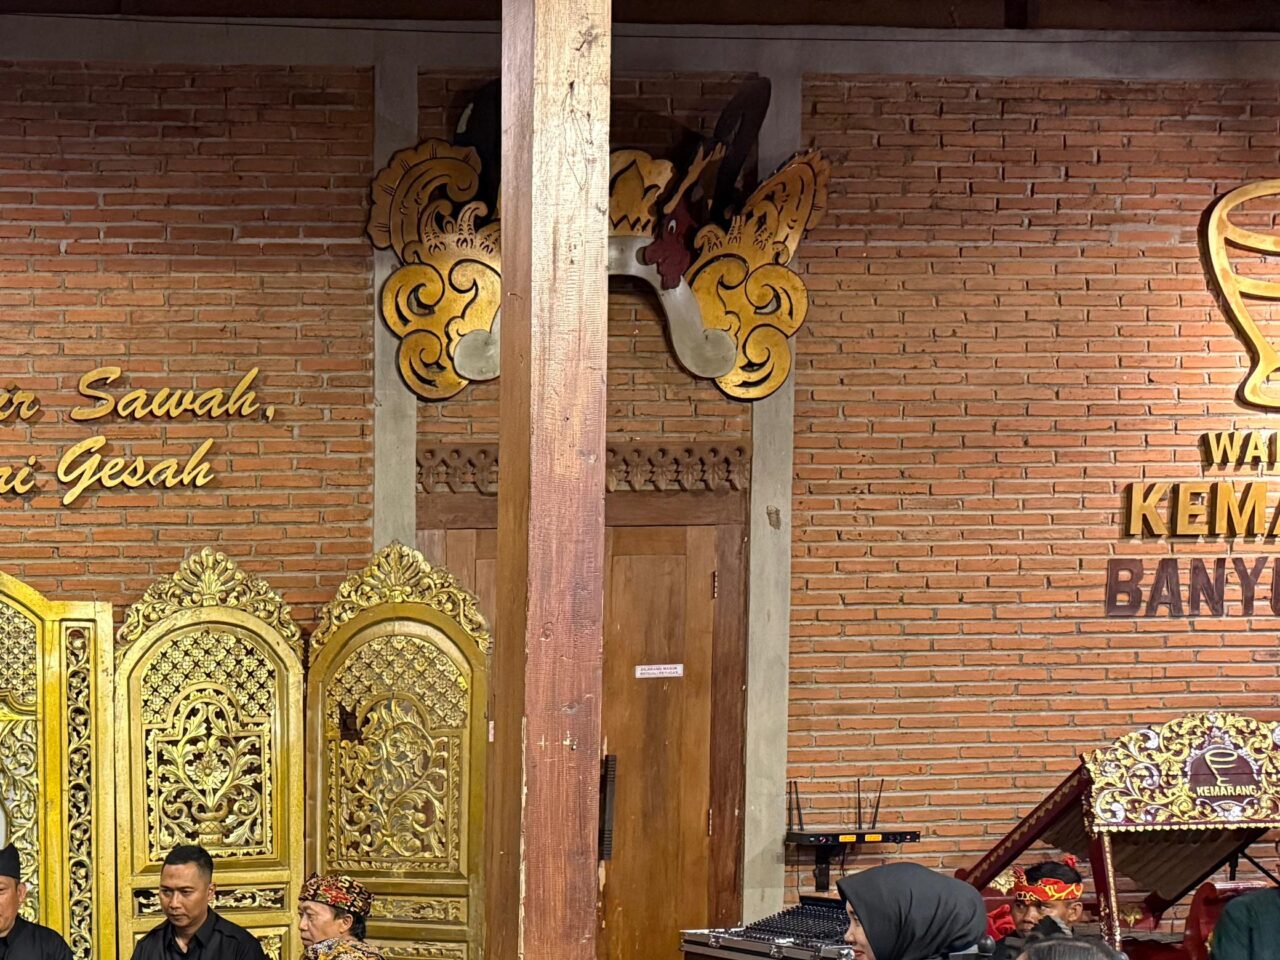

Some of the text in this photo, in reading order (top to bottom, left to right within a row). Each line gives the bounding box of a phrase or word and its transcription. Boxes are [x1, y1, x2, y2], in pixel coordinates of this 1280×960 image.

[69, 366, 275, 422] Sawah,
[57, 435, 215, 506] Gesah
[1207, 431, 1280, 464] WA
[1130, 481, 1280, 535] KEM
[1105, 557, 1280, 618] BANY
[1196, 785, 1257, 797] KEMARANG
